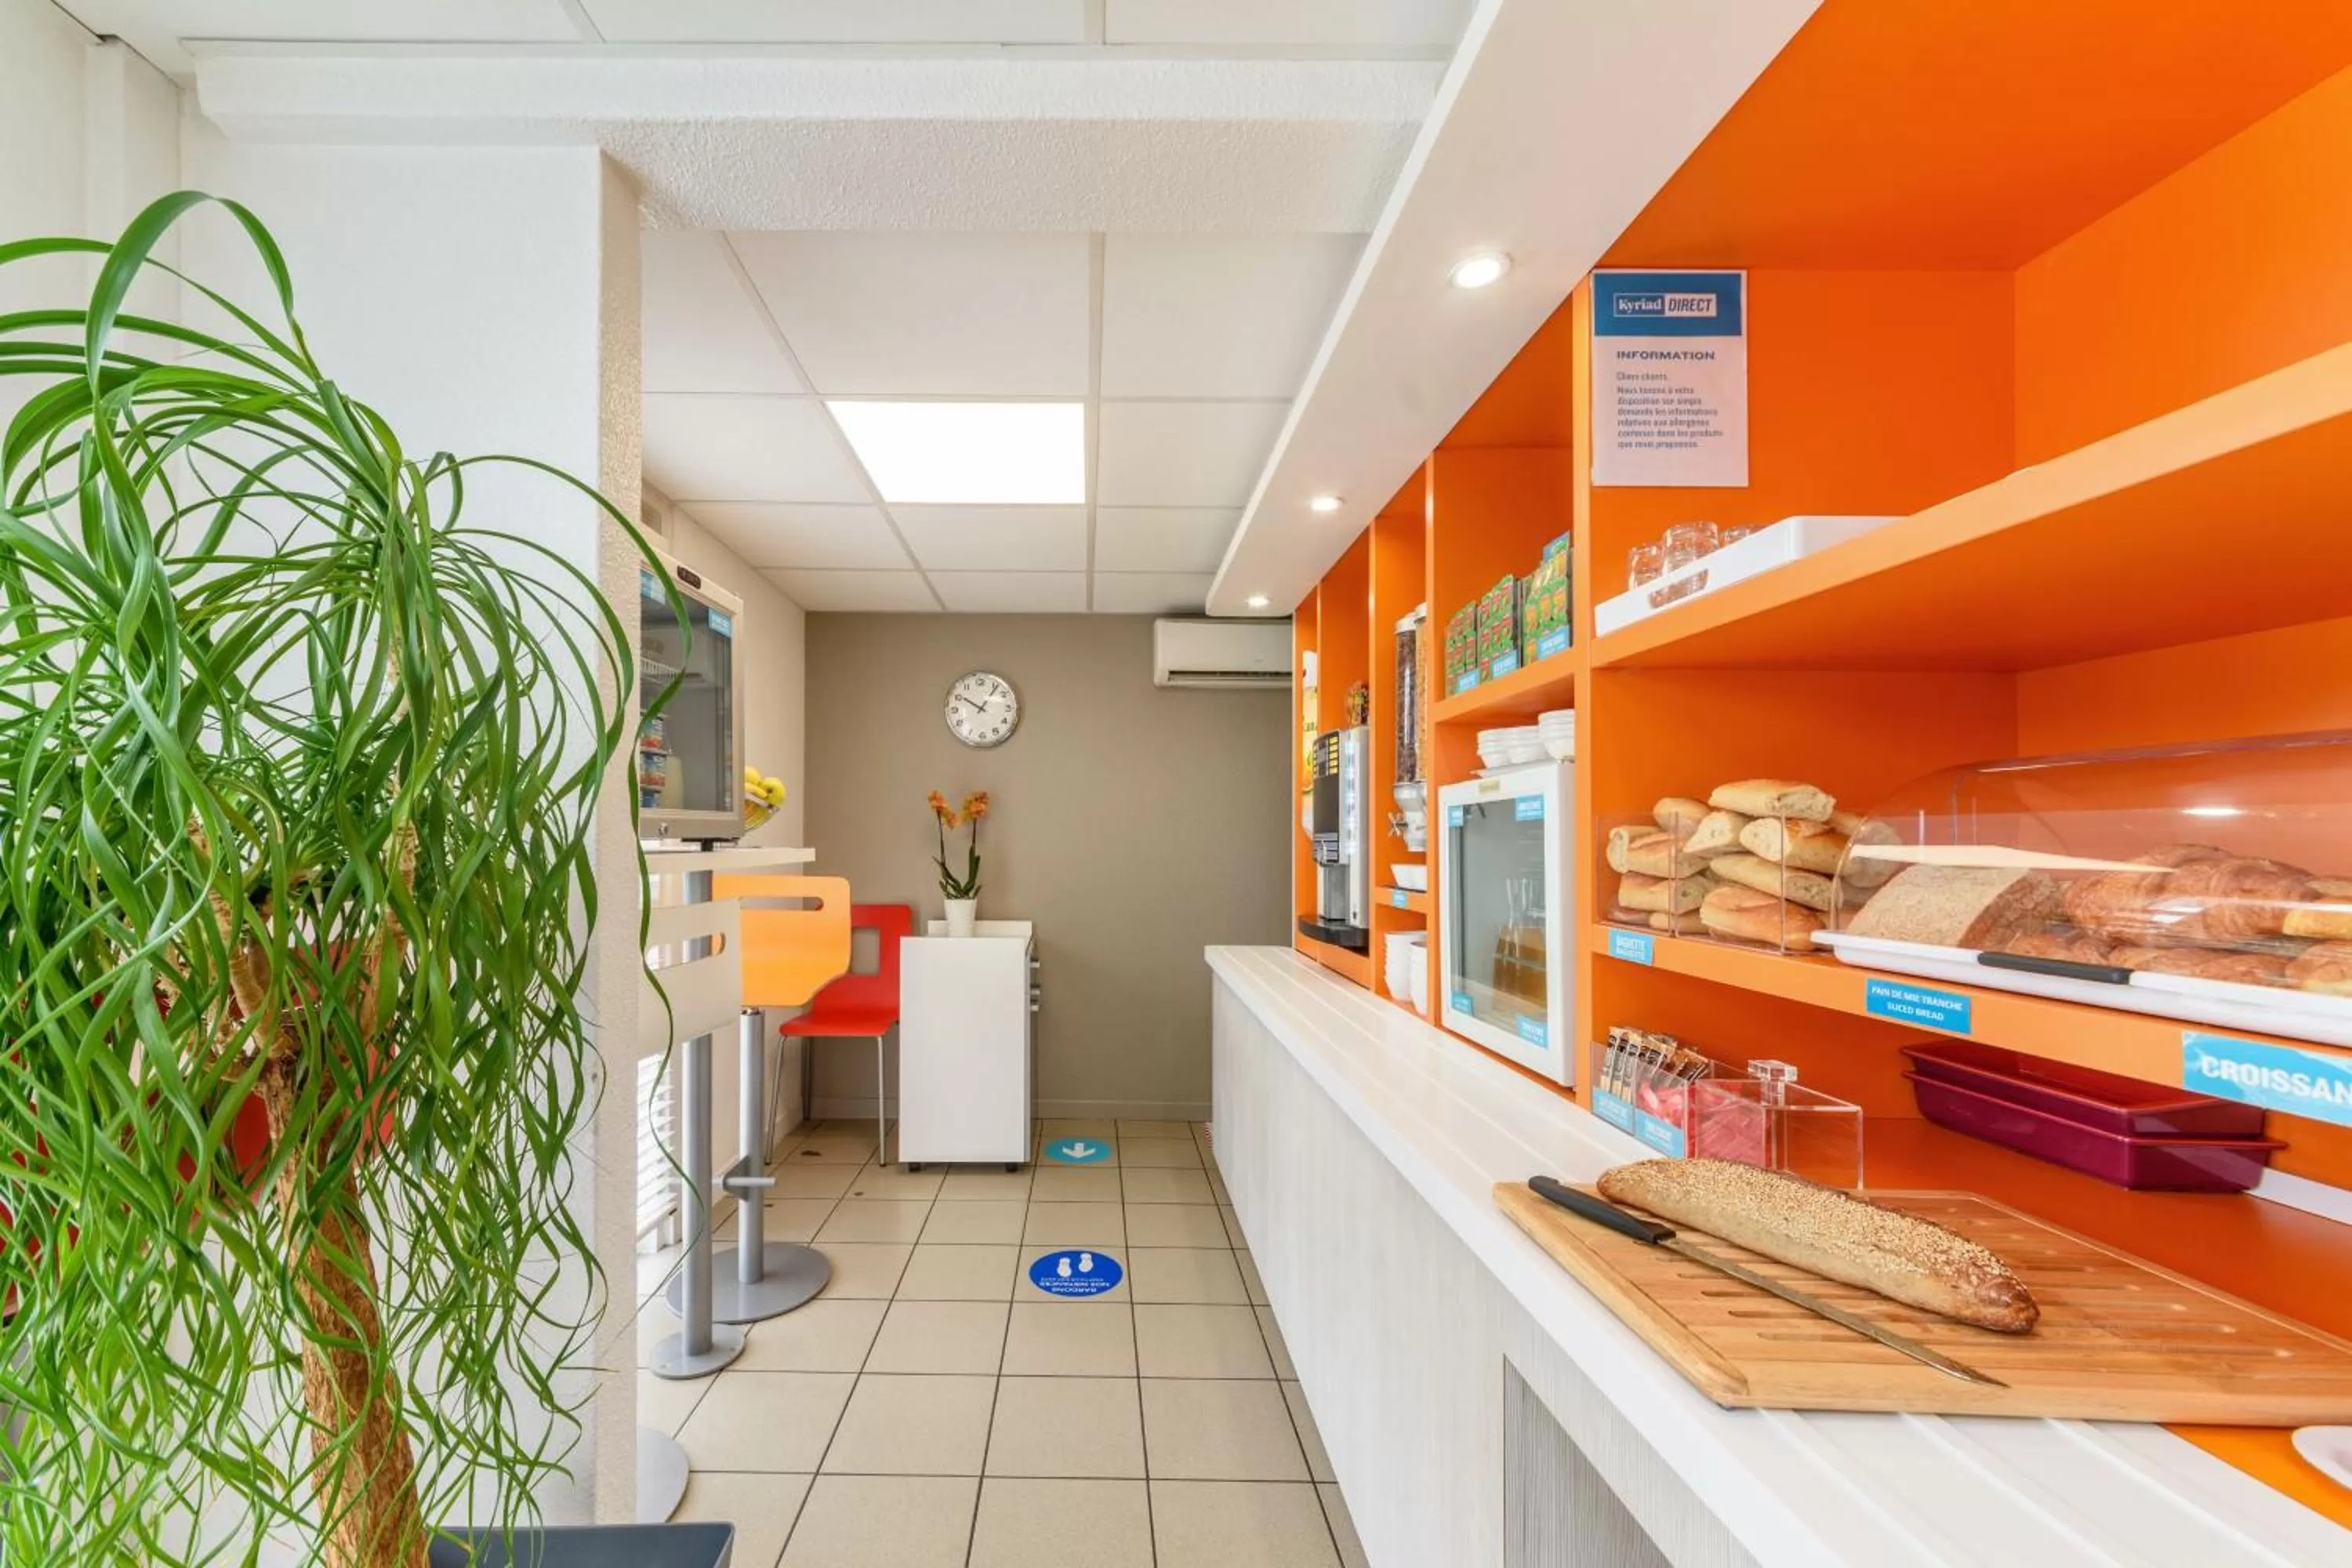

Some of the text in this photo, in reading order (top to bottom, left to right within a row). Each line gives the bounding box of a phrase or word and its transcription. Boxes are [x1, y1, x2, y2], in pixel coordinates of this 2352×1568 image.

[1618, 298, 1713, 314] Kyriad DIRECT
[1616, 350, 1715, 361] INFORMATION
[1871, 986, 1889, 996] PAIN
[1891, 989, 1902, 999] DE
[1902, 992, 1920, 1004] MIE
[1915, 1007, 1944, 1020] BREAD
